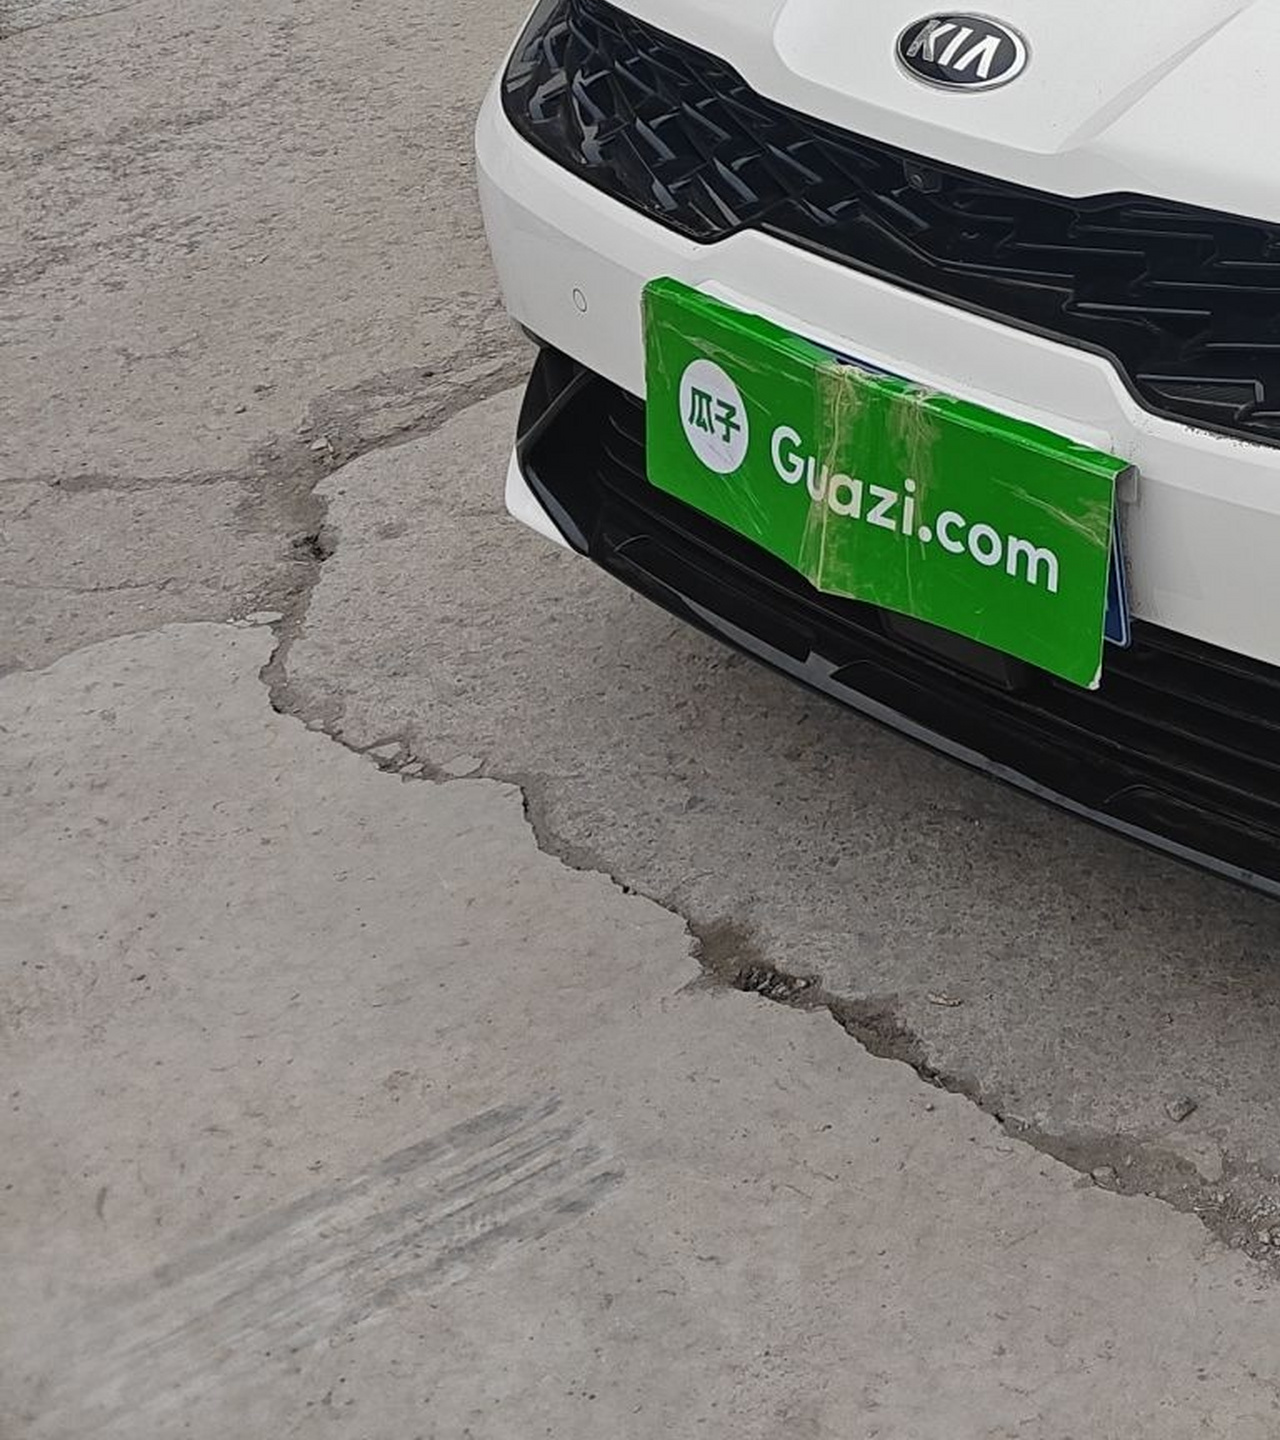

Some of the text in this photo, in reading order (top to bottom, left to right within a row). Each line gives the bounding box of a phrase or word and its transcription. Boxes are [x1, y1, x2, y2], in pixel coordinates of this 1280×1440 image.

[907, 20, 1001, 79] KIA
[688, 386, 741, 444] 瓜子
[771, 425, 1059, 594] Guazi.com
